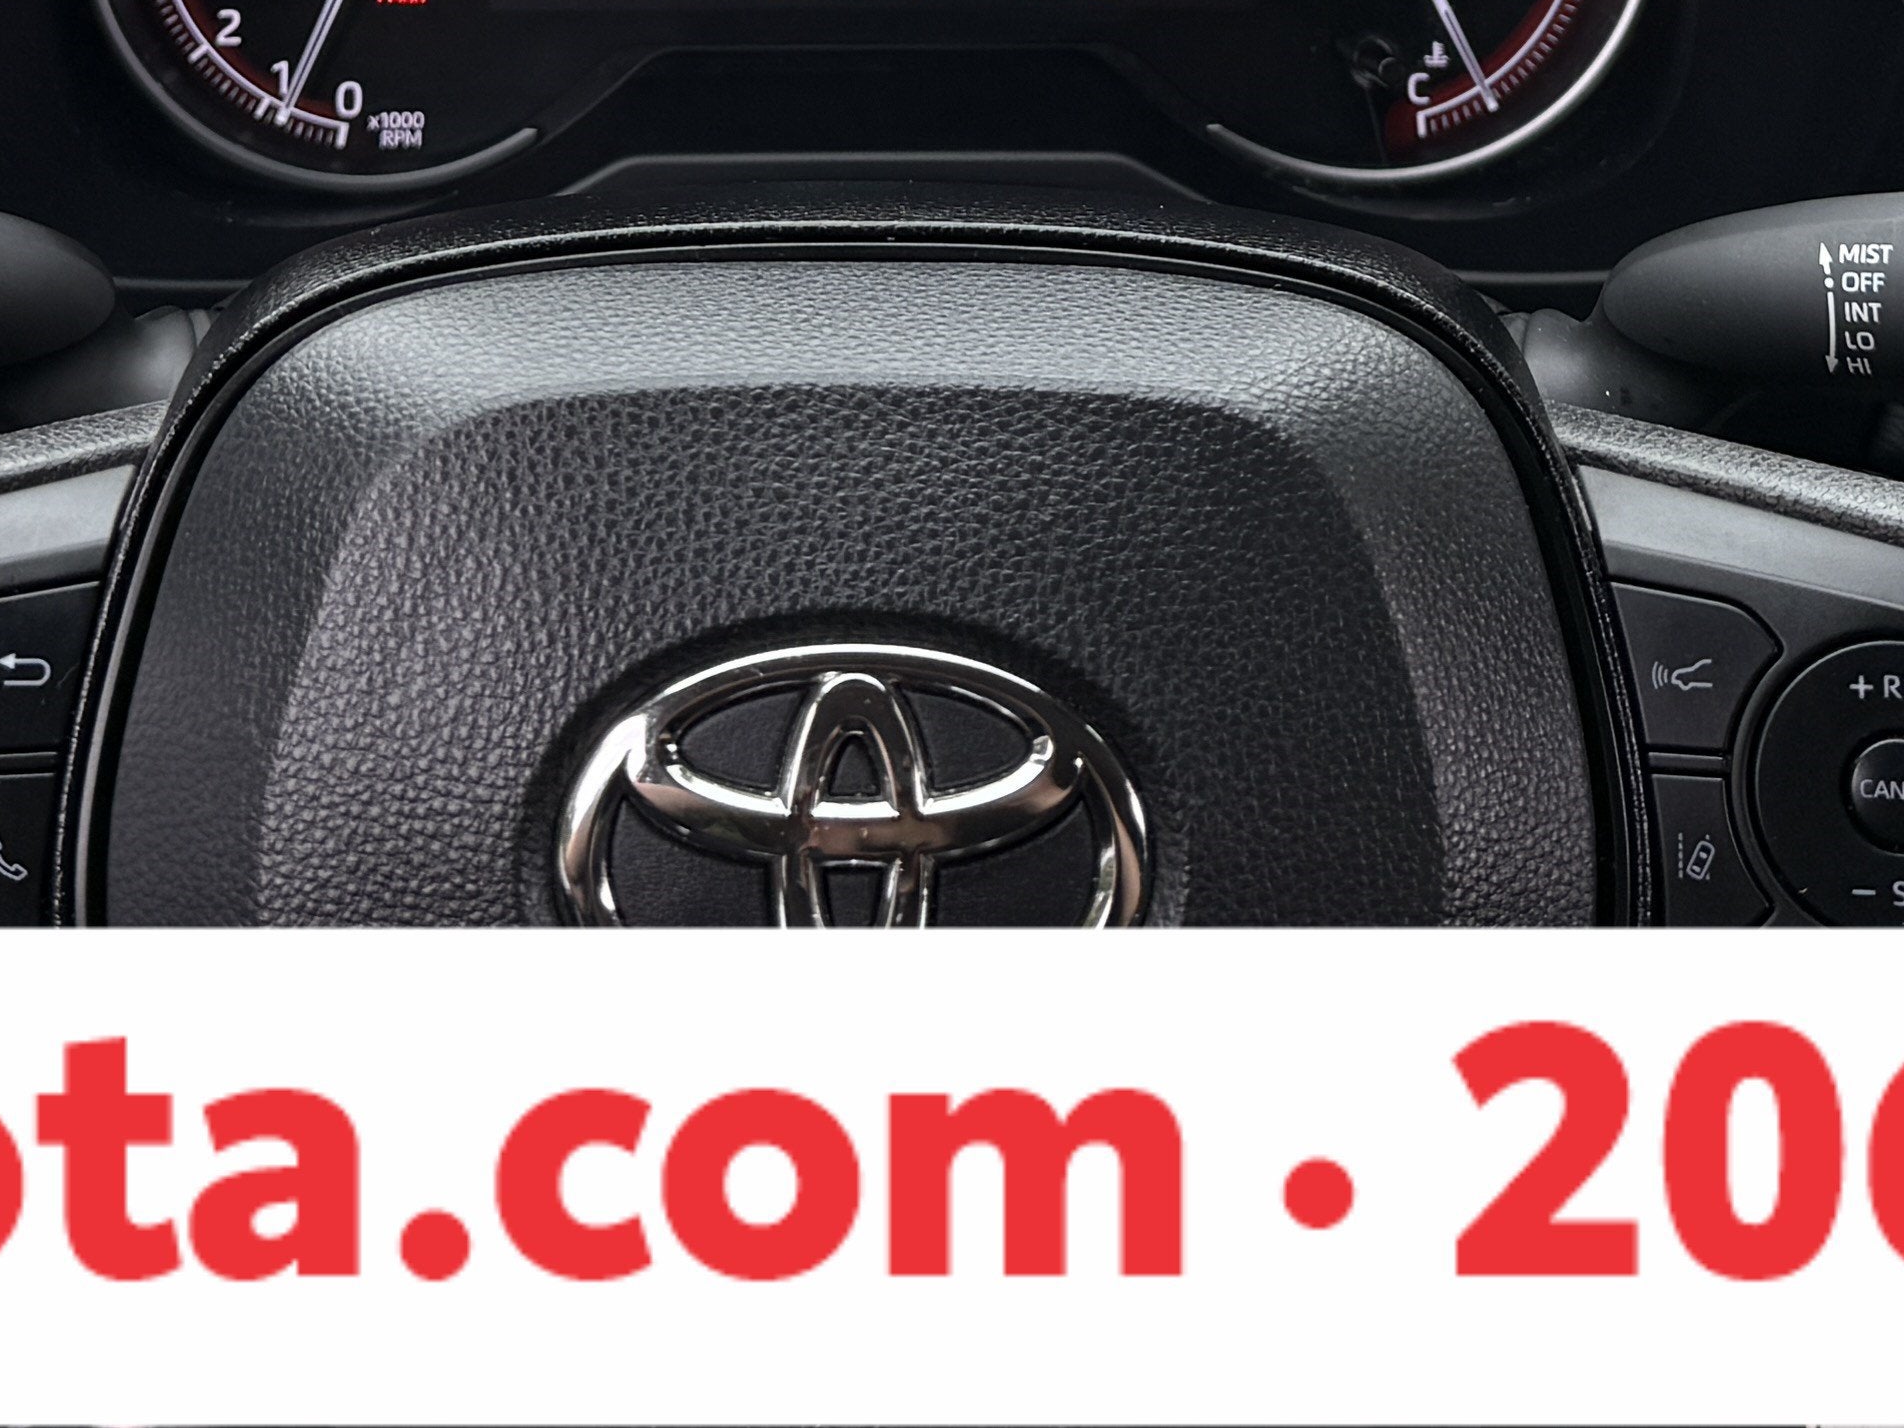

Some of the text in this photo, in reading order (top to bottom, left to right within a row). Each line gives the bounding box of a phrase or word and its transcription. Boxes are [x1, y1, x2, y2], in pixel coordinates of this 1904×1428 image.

[214, 8, 242, 46] 2
[270, 60, 290, 97] 1
[1407, 72, 1430, 106] C
[334, 80, 364, 119] 0
[379, 129, 424, 149] RPM
[1838, 243, 1894, 266] MIST
[1840, 271, 1886, 294] OFF
[1843, 301, 1882, 324] INT
[1845, 330, 1876, 352] LO
[1847, 355, 1873, 375] HI
